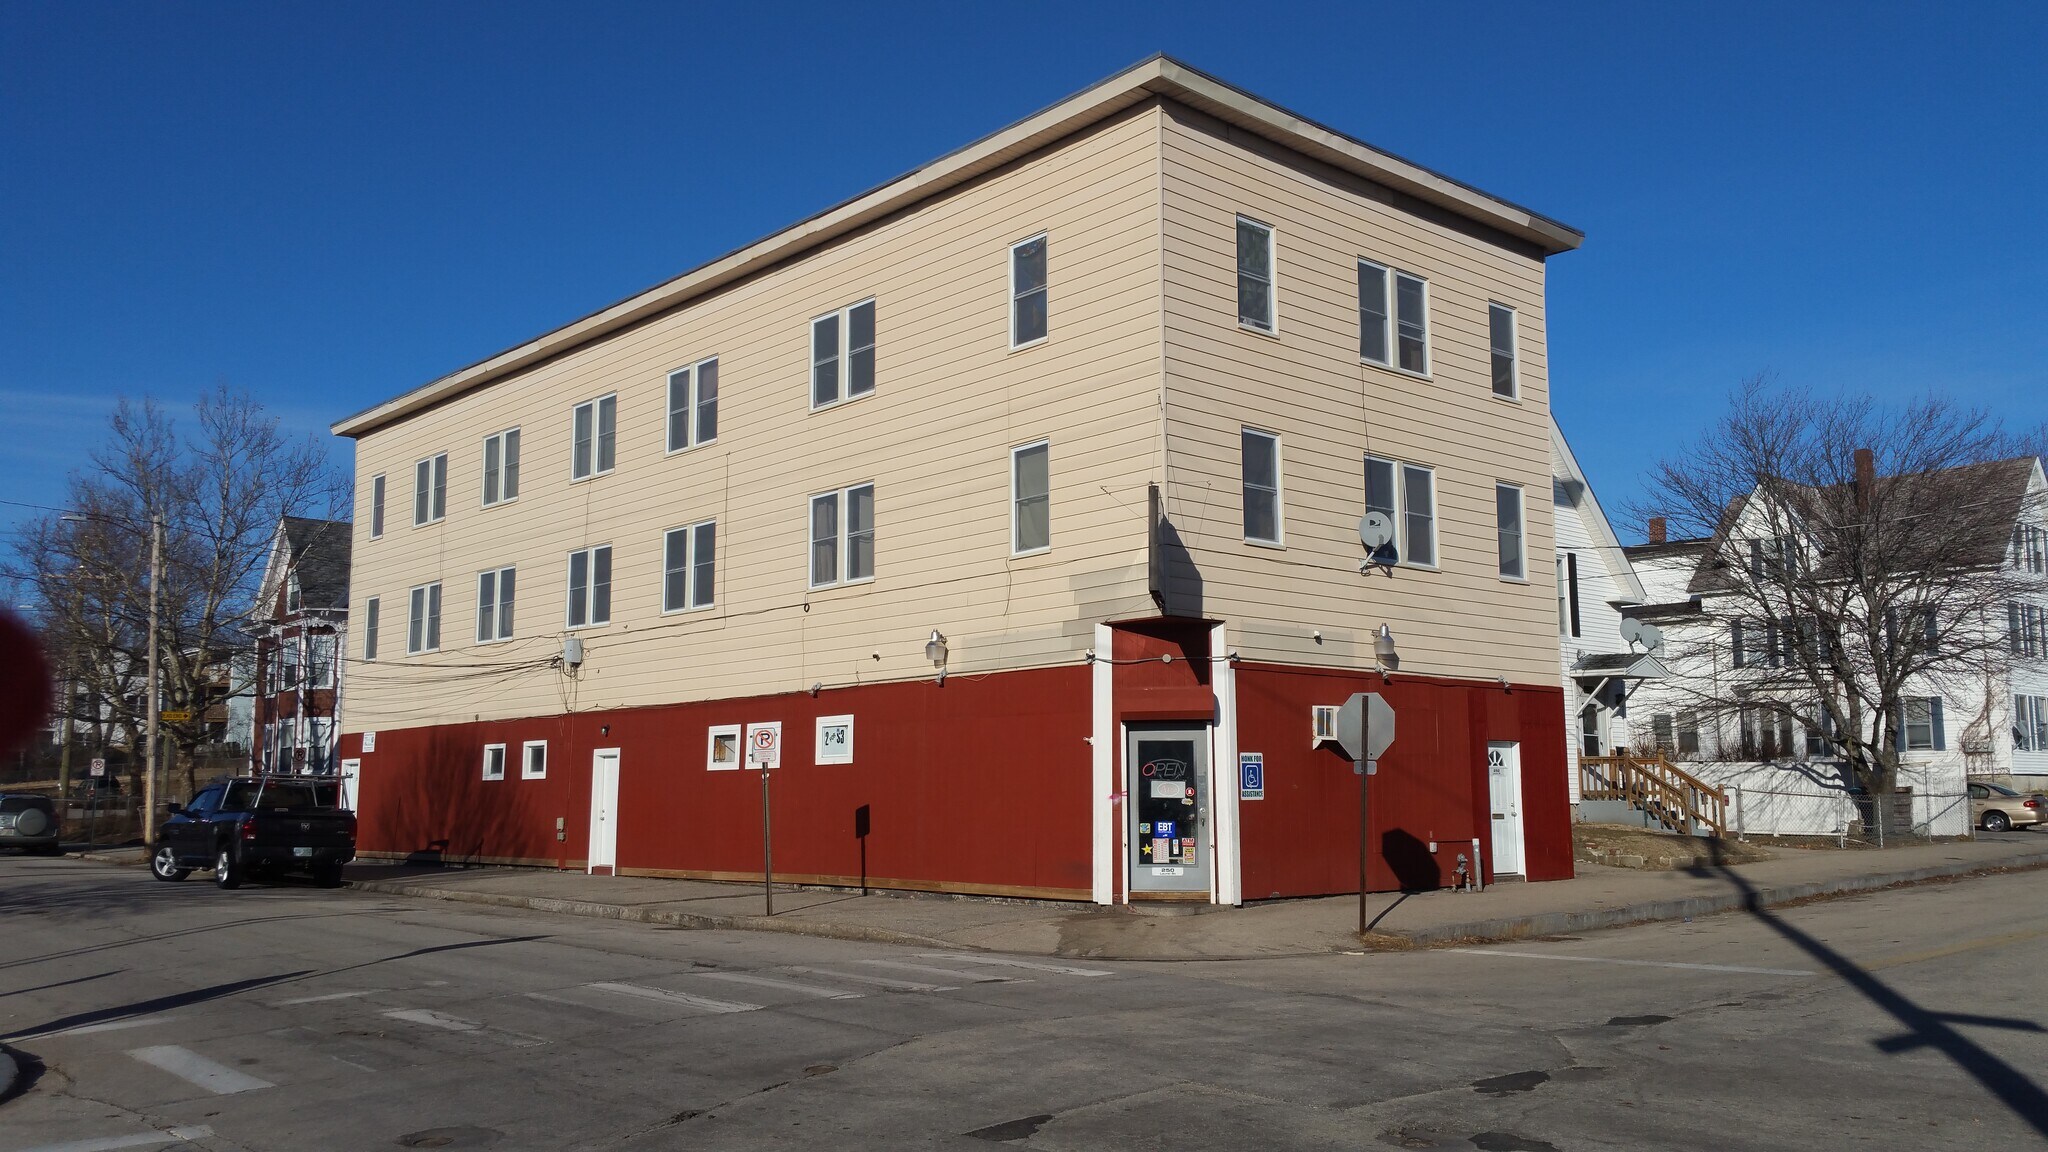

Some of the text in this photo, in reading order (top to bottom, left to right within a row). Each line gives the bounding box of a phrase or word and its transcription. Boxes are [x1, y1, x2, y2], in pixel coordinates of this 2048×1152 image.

[760, 733, 770, 745] P
[825, 731, 829, 746] 2
[1142, 762, 1187, 777] OPEN
[1242, 790, 1263, 798] ASSISTANCE
[1158, 822, 1173, 832] EBT
